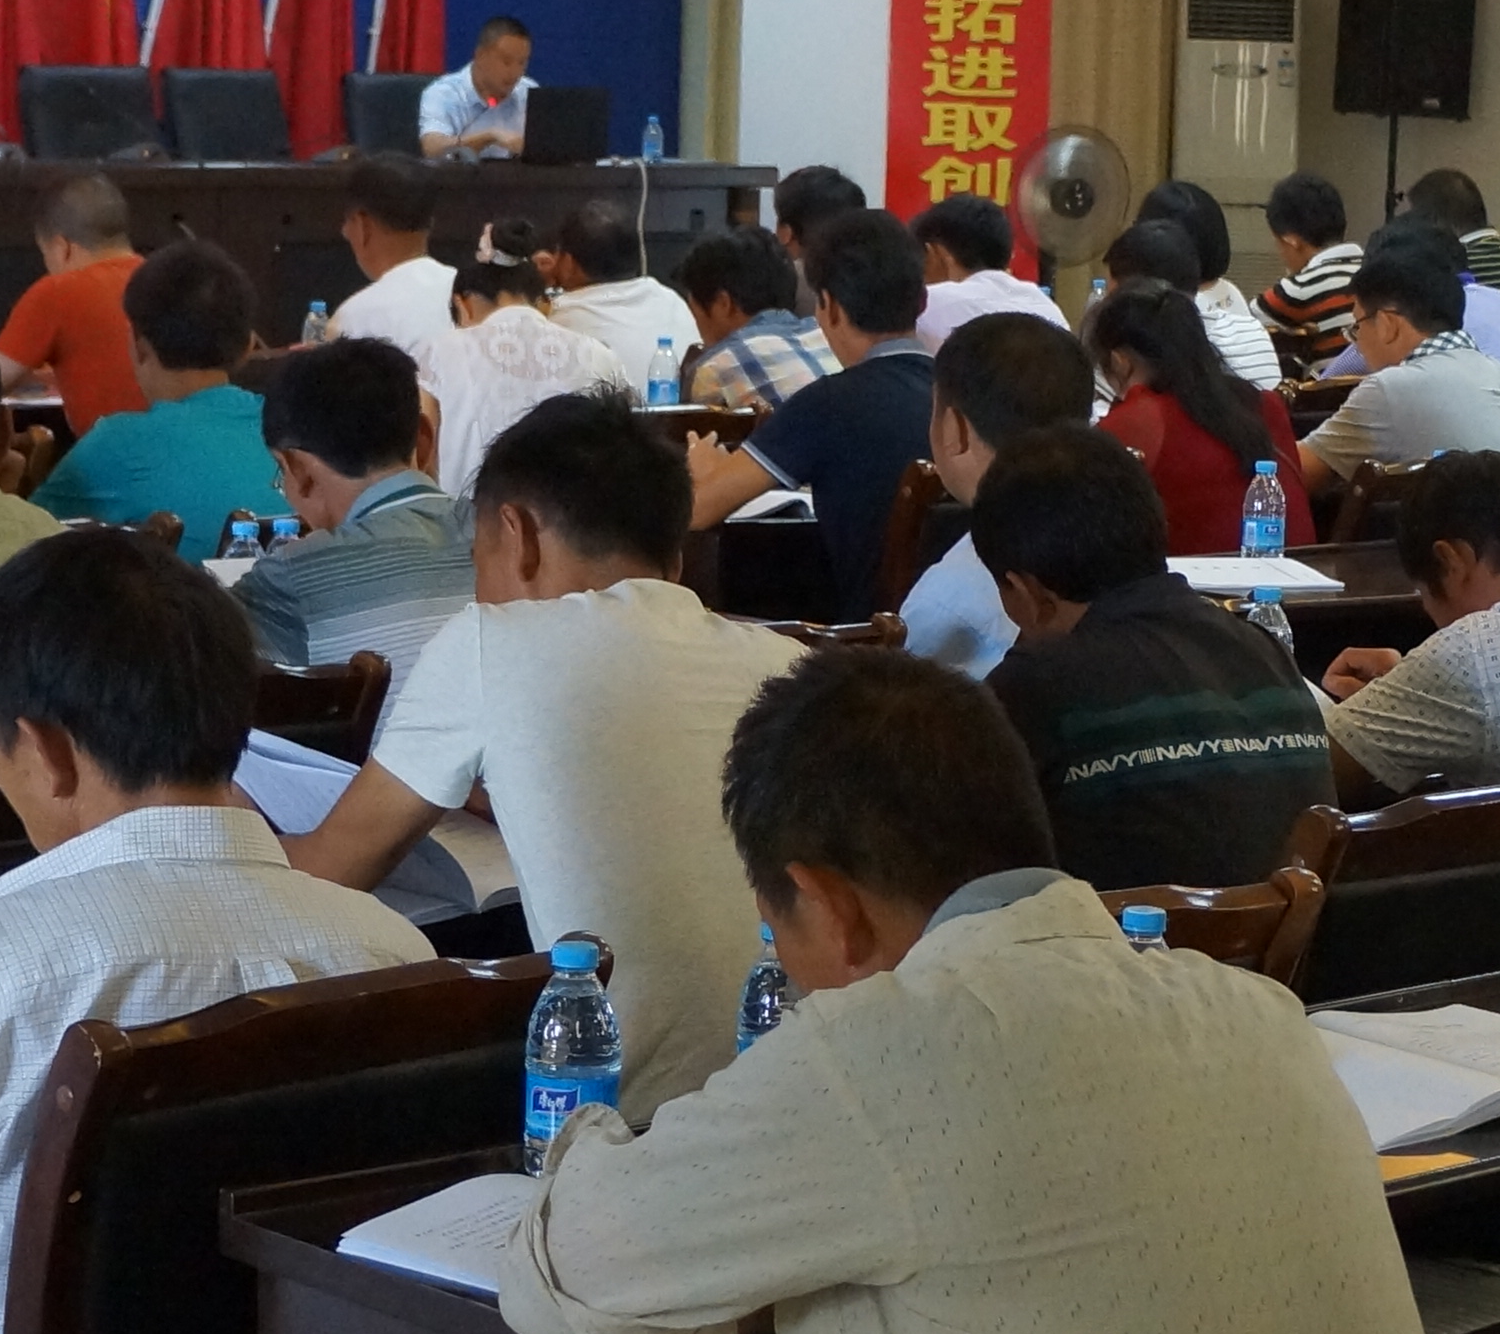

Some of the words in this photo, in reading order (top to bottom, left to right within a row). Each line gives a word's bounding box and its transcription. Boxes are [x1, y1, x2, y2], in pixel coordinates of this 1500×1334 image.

[1069, 751, 1138, 782] NAVY
[1156, 739, 1221, 762] NAVY
[1233, 734, 1286, 753] NAVY
